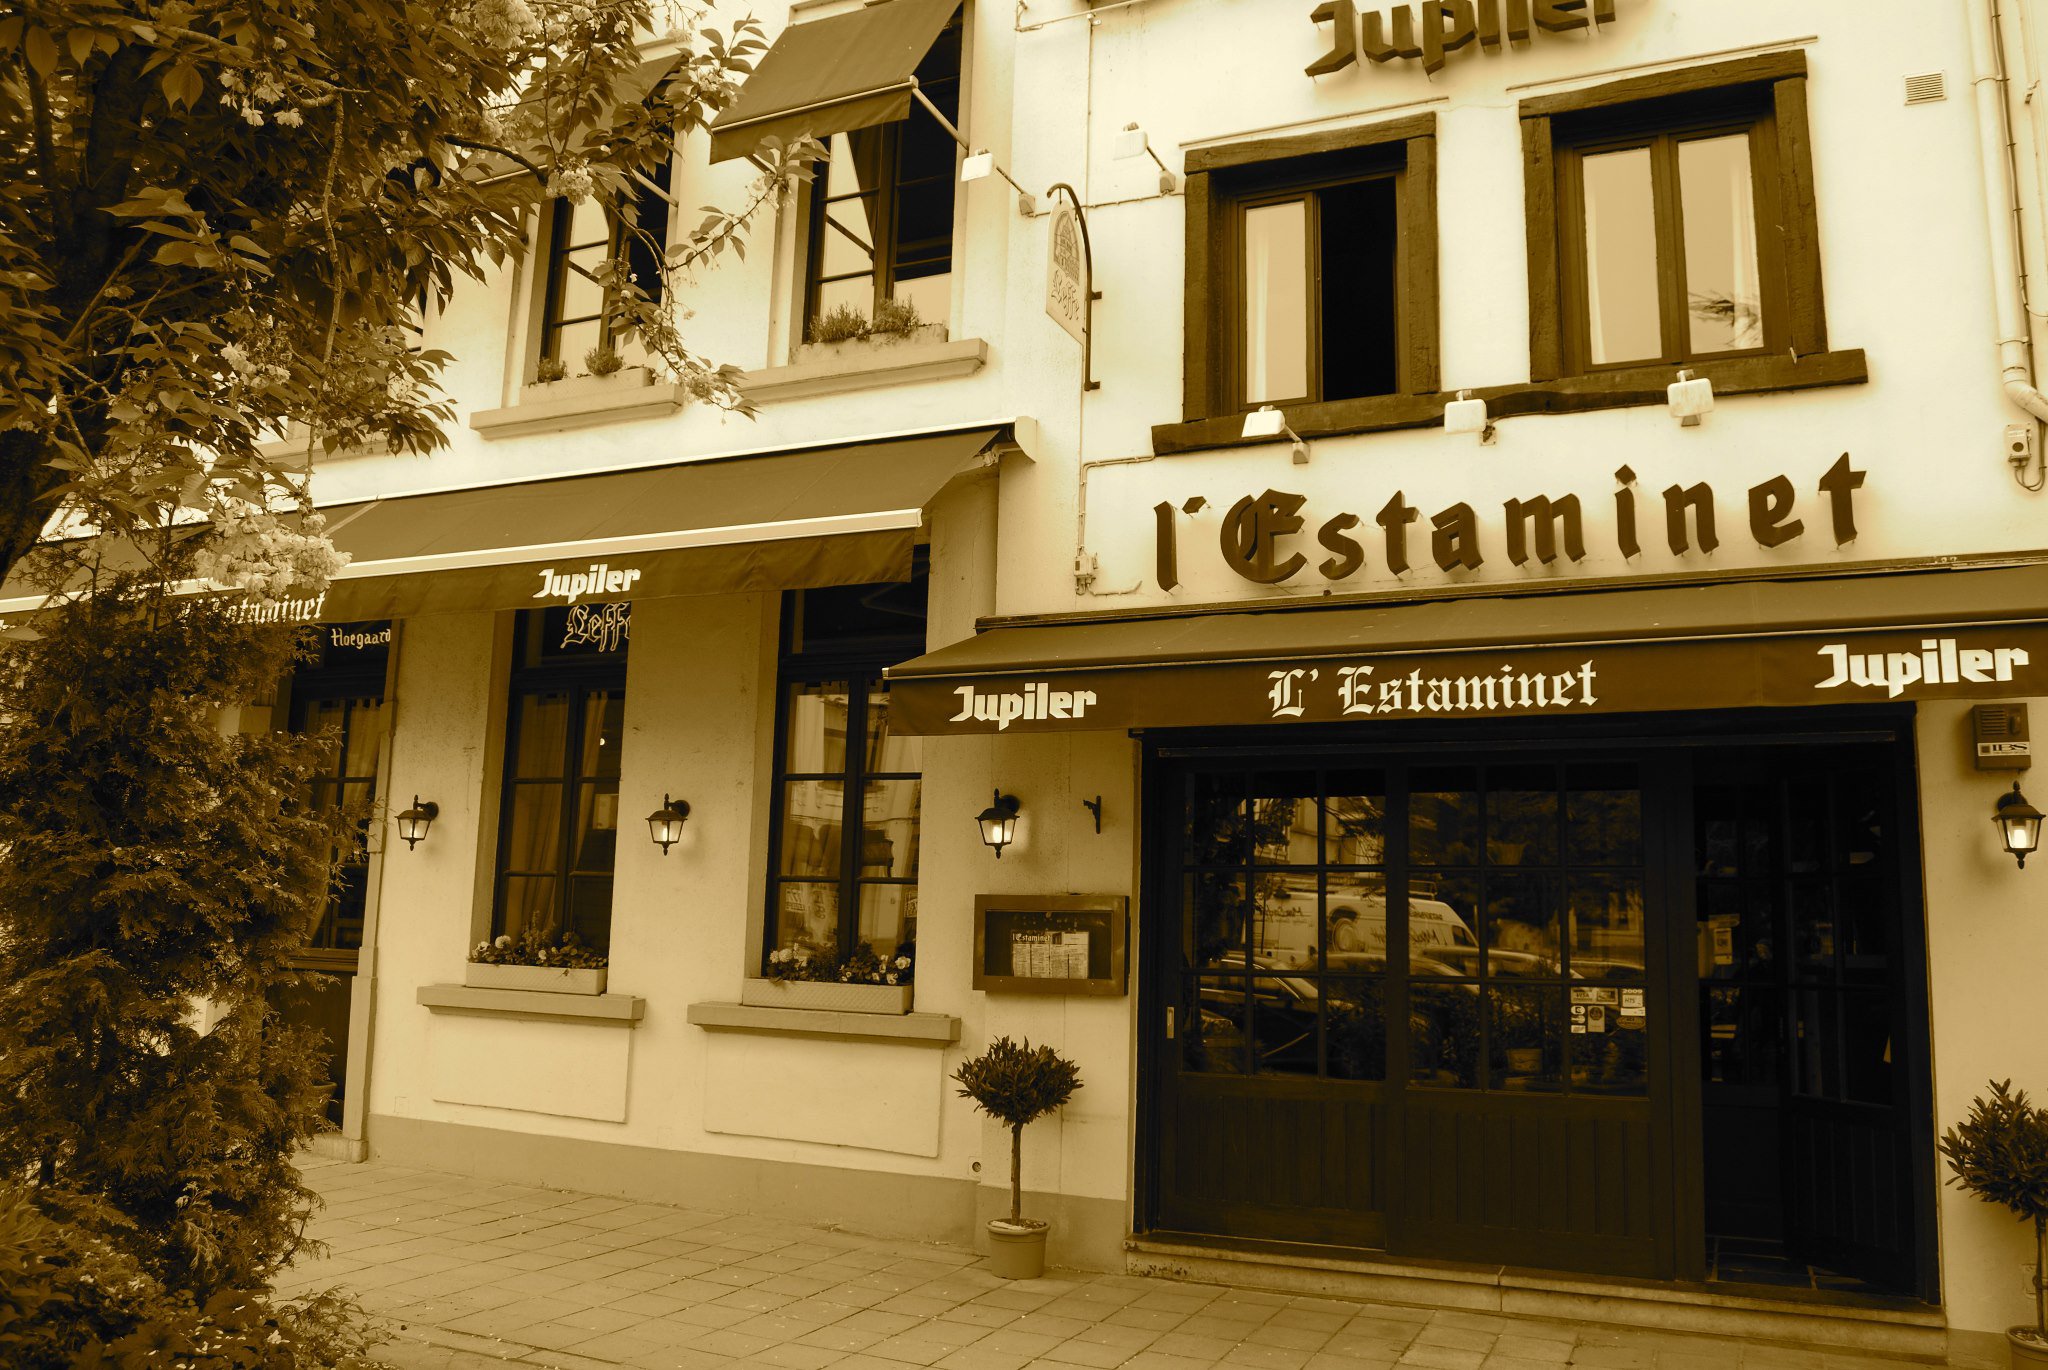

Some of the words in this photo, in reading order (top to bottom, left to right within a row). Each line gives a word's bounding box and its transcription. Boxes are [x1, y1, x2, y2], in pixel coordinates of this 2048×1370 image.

[1051, 268, 1080, 321] Leffe
[208, 591, 326, 625] staminet
[533, 564, 641, 604] Jupiler
[1337, 659, 1599, 715] Estaminet
[1814, 638, 2030, 699] Jupiler
[949, 682, 1097, 731] Jupiler
